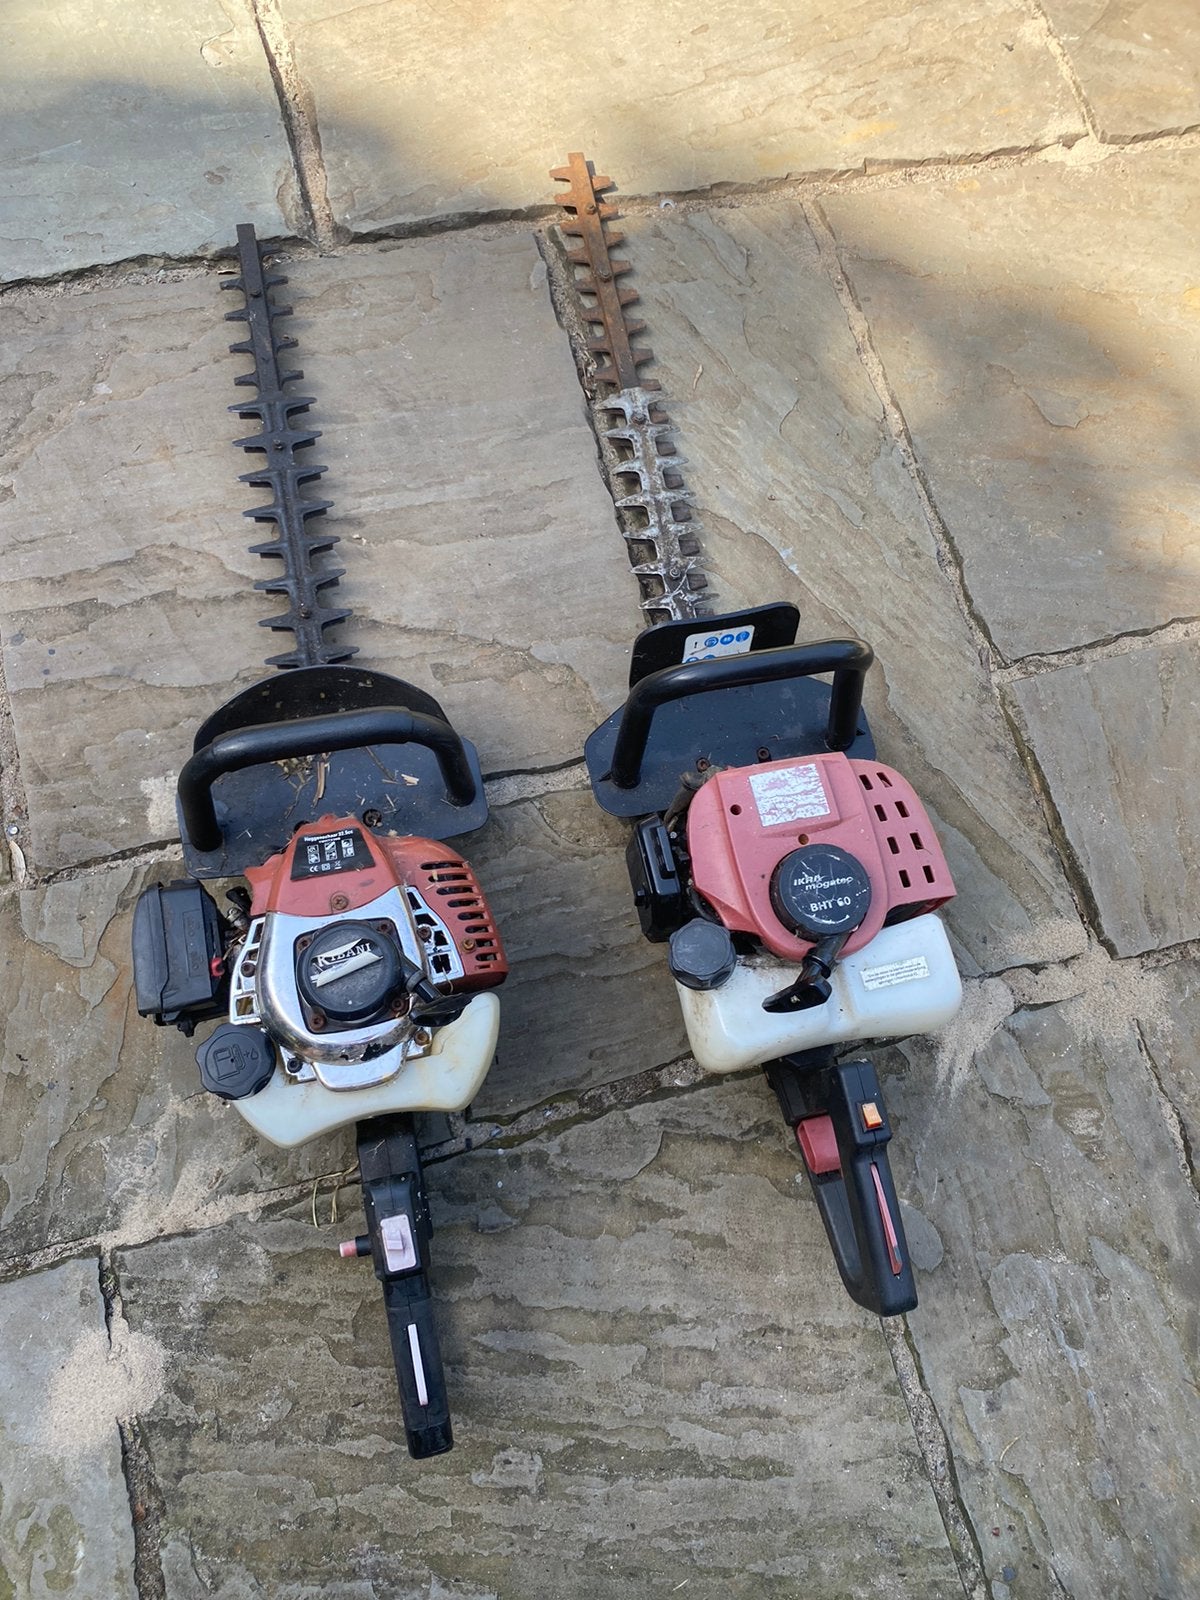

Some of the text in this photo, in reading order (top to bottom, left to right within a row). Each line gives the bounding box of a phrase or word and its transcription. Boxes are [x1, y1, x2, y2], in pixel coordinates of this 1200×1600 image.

[793, 874, 823, 886] IKRA
[810, 896, 851, 912] BHT 60
